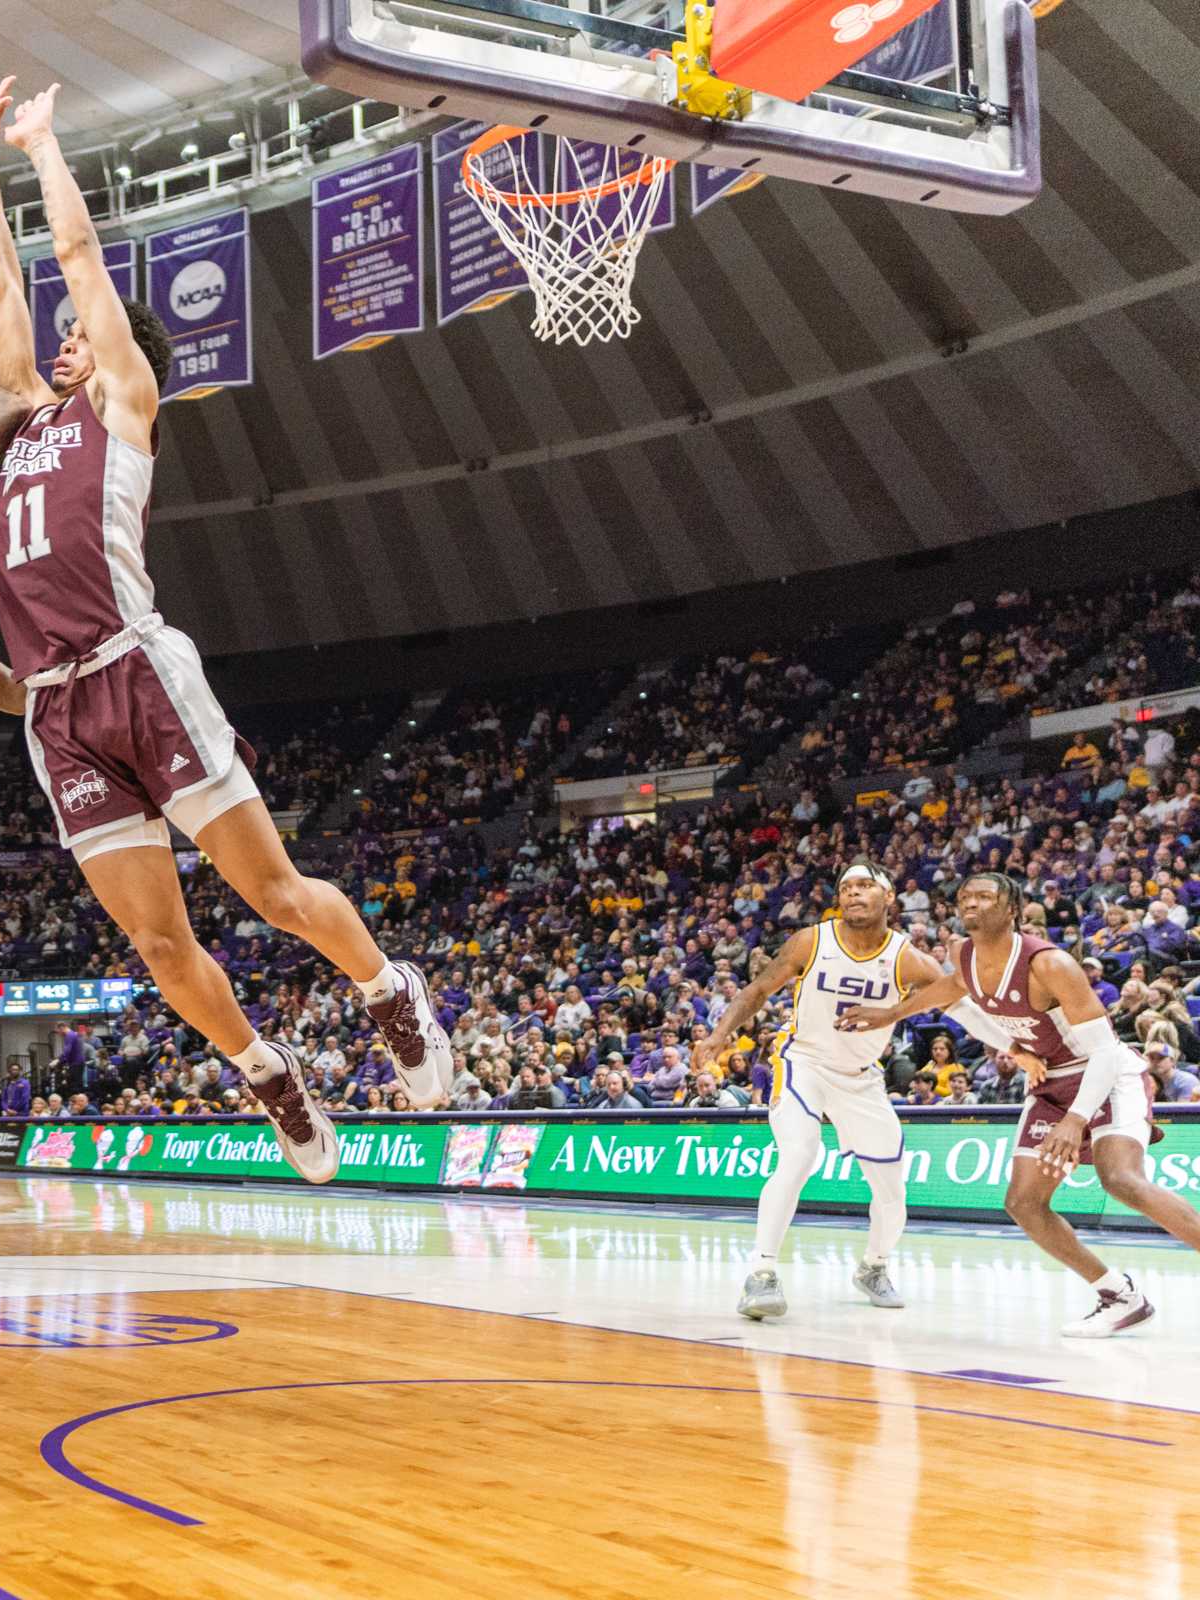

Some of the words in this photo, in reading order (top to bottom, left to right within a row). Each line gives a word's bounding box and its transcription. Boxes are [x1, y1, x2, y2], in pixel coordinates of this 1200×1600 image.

[331, 215, 404, 253] BREAUX
[176, 283, 225, 309] NCAA
[200, 333, 230, 351] FOUR
[178, 351, 218, 378] 1991
[5, 484, 52, 570] 11
[68, 781, 101, 802] STATE
[817, 971, 890, 1001] LSU
[161, 1132, 205, 1168] Tony
[373, 1133, 426, 1169] Mix.
[549, 1134, 576, 1172] A
[582, 1135, 666, 1175] New
[674, 1134, 779, 1178] Twist
[945, 1136, 1013, 1187] Ol
